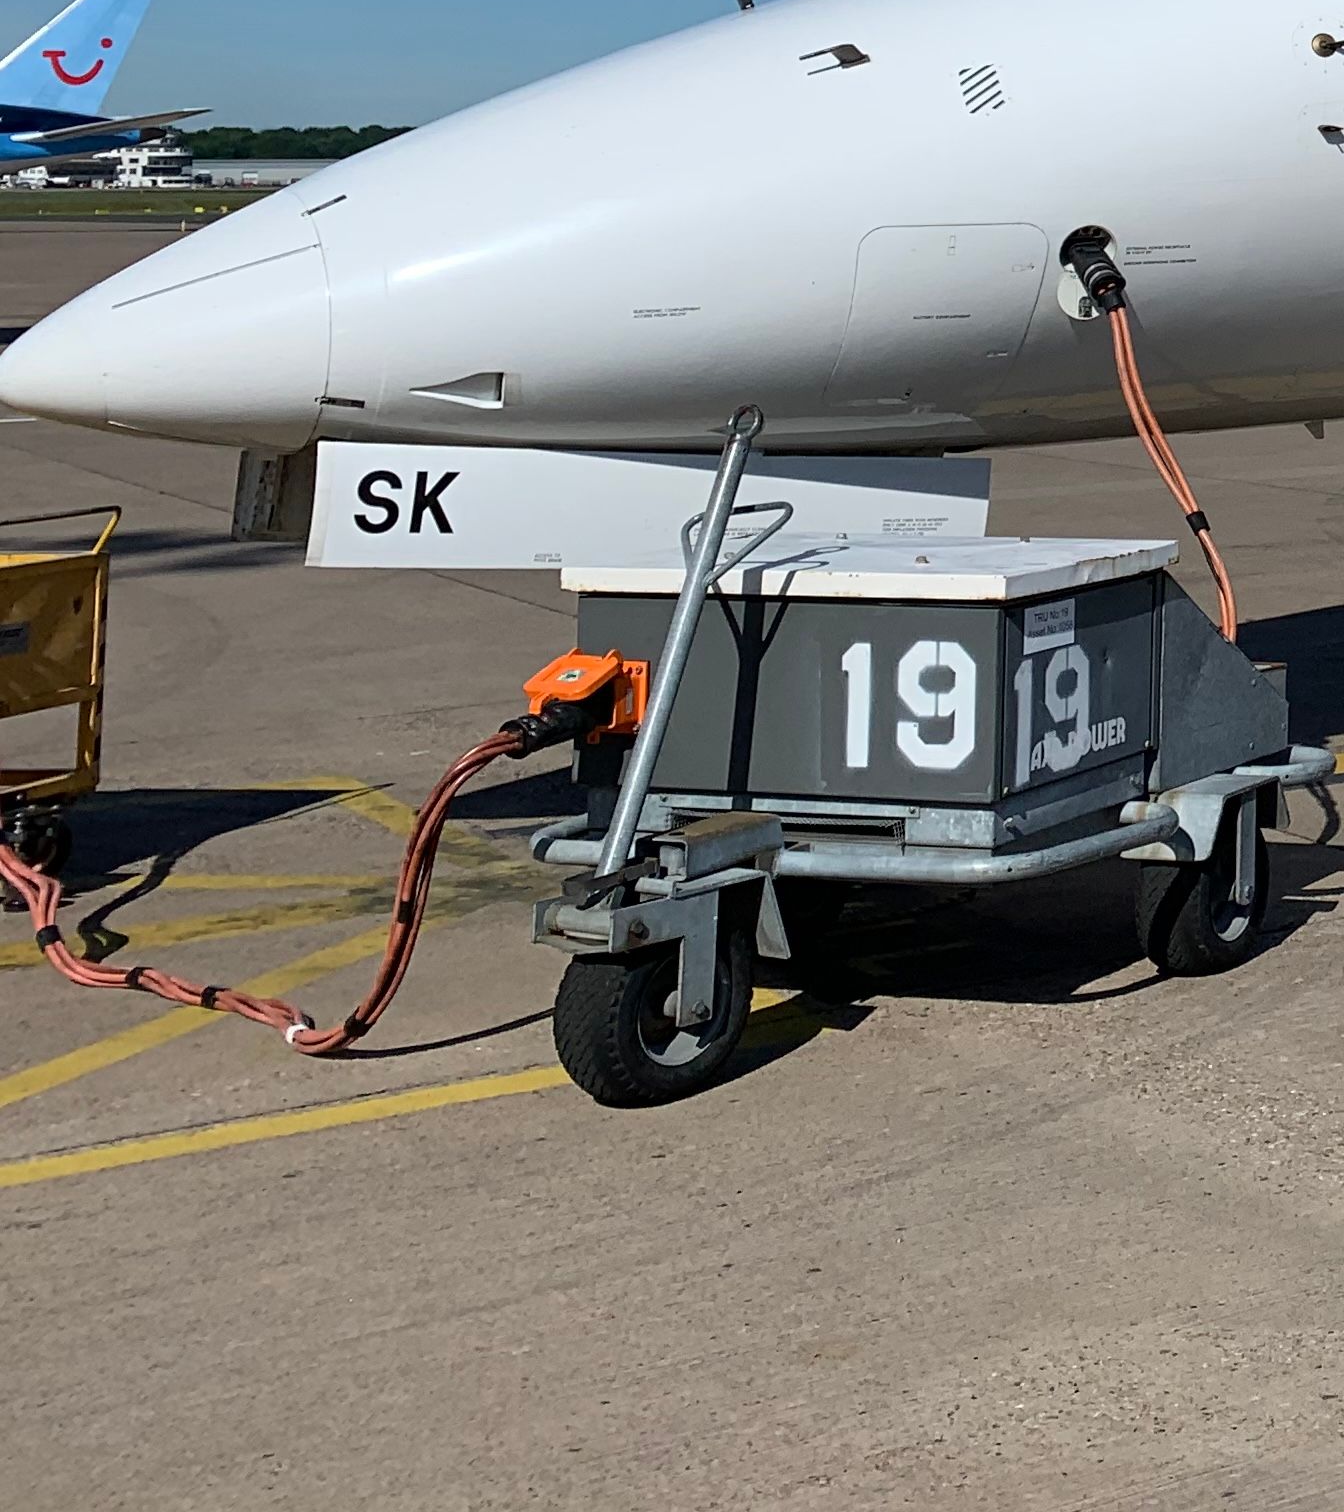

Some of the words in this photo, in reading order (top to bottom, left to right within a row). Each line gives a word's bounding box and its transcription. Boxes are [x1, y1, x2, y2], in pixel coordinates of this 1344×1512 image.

[353, 470, 461, 534] SK
[841, 640, 977, 770] 19
[1014, 644, 1090, 788] 19
